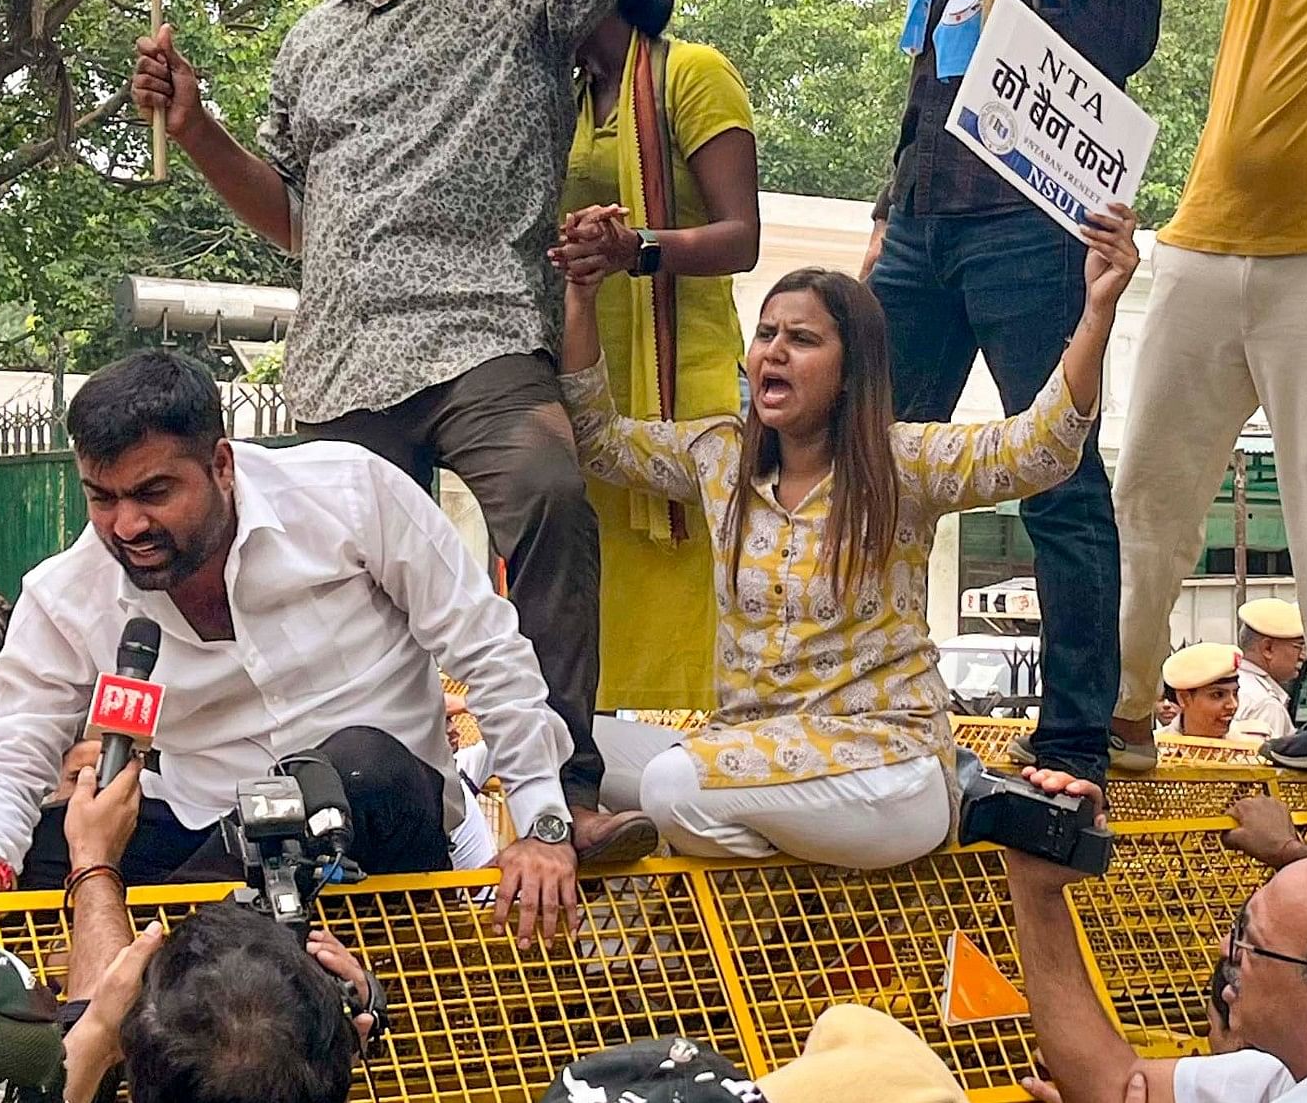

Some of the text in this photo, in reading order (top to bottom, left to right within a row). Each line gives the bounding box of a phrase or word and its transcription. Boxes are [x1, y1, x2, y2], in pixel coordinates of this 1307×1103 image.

[1039, 47, 1104, 124] NTA
[992, 58, 1030, 111] को
[1029, 82, 1075, 150] बैन
[1074, 129, 1127, 194] करो
[1027, 165, 1081, 220] NSUI
[99, 684, 154, 725] PTI
